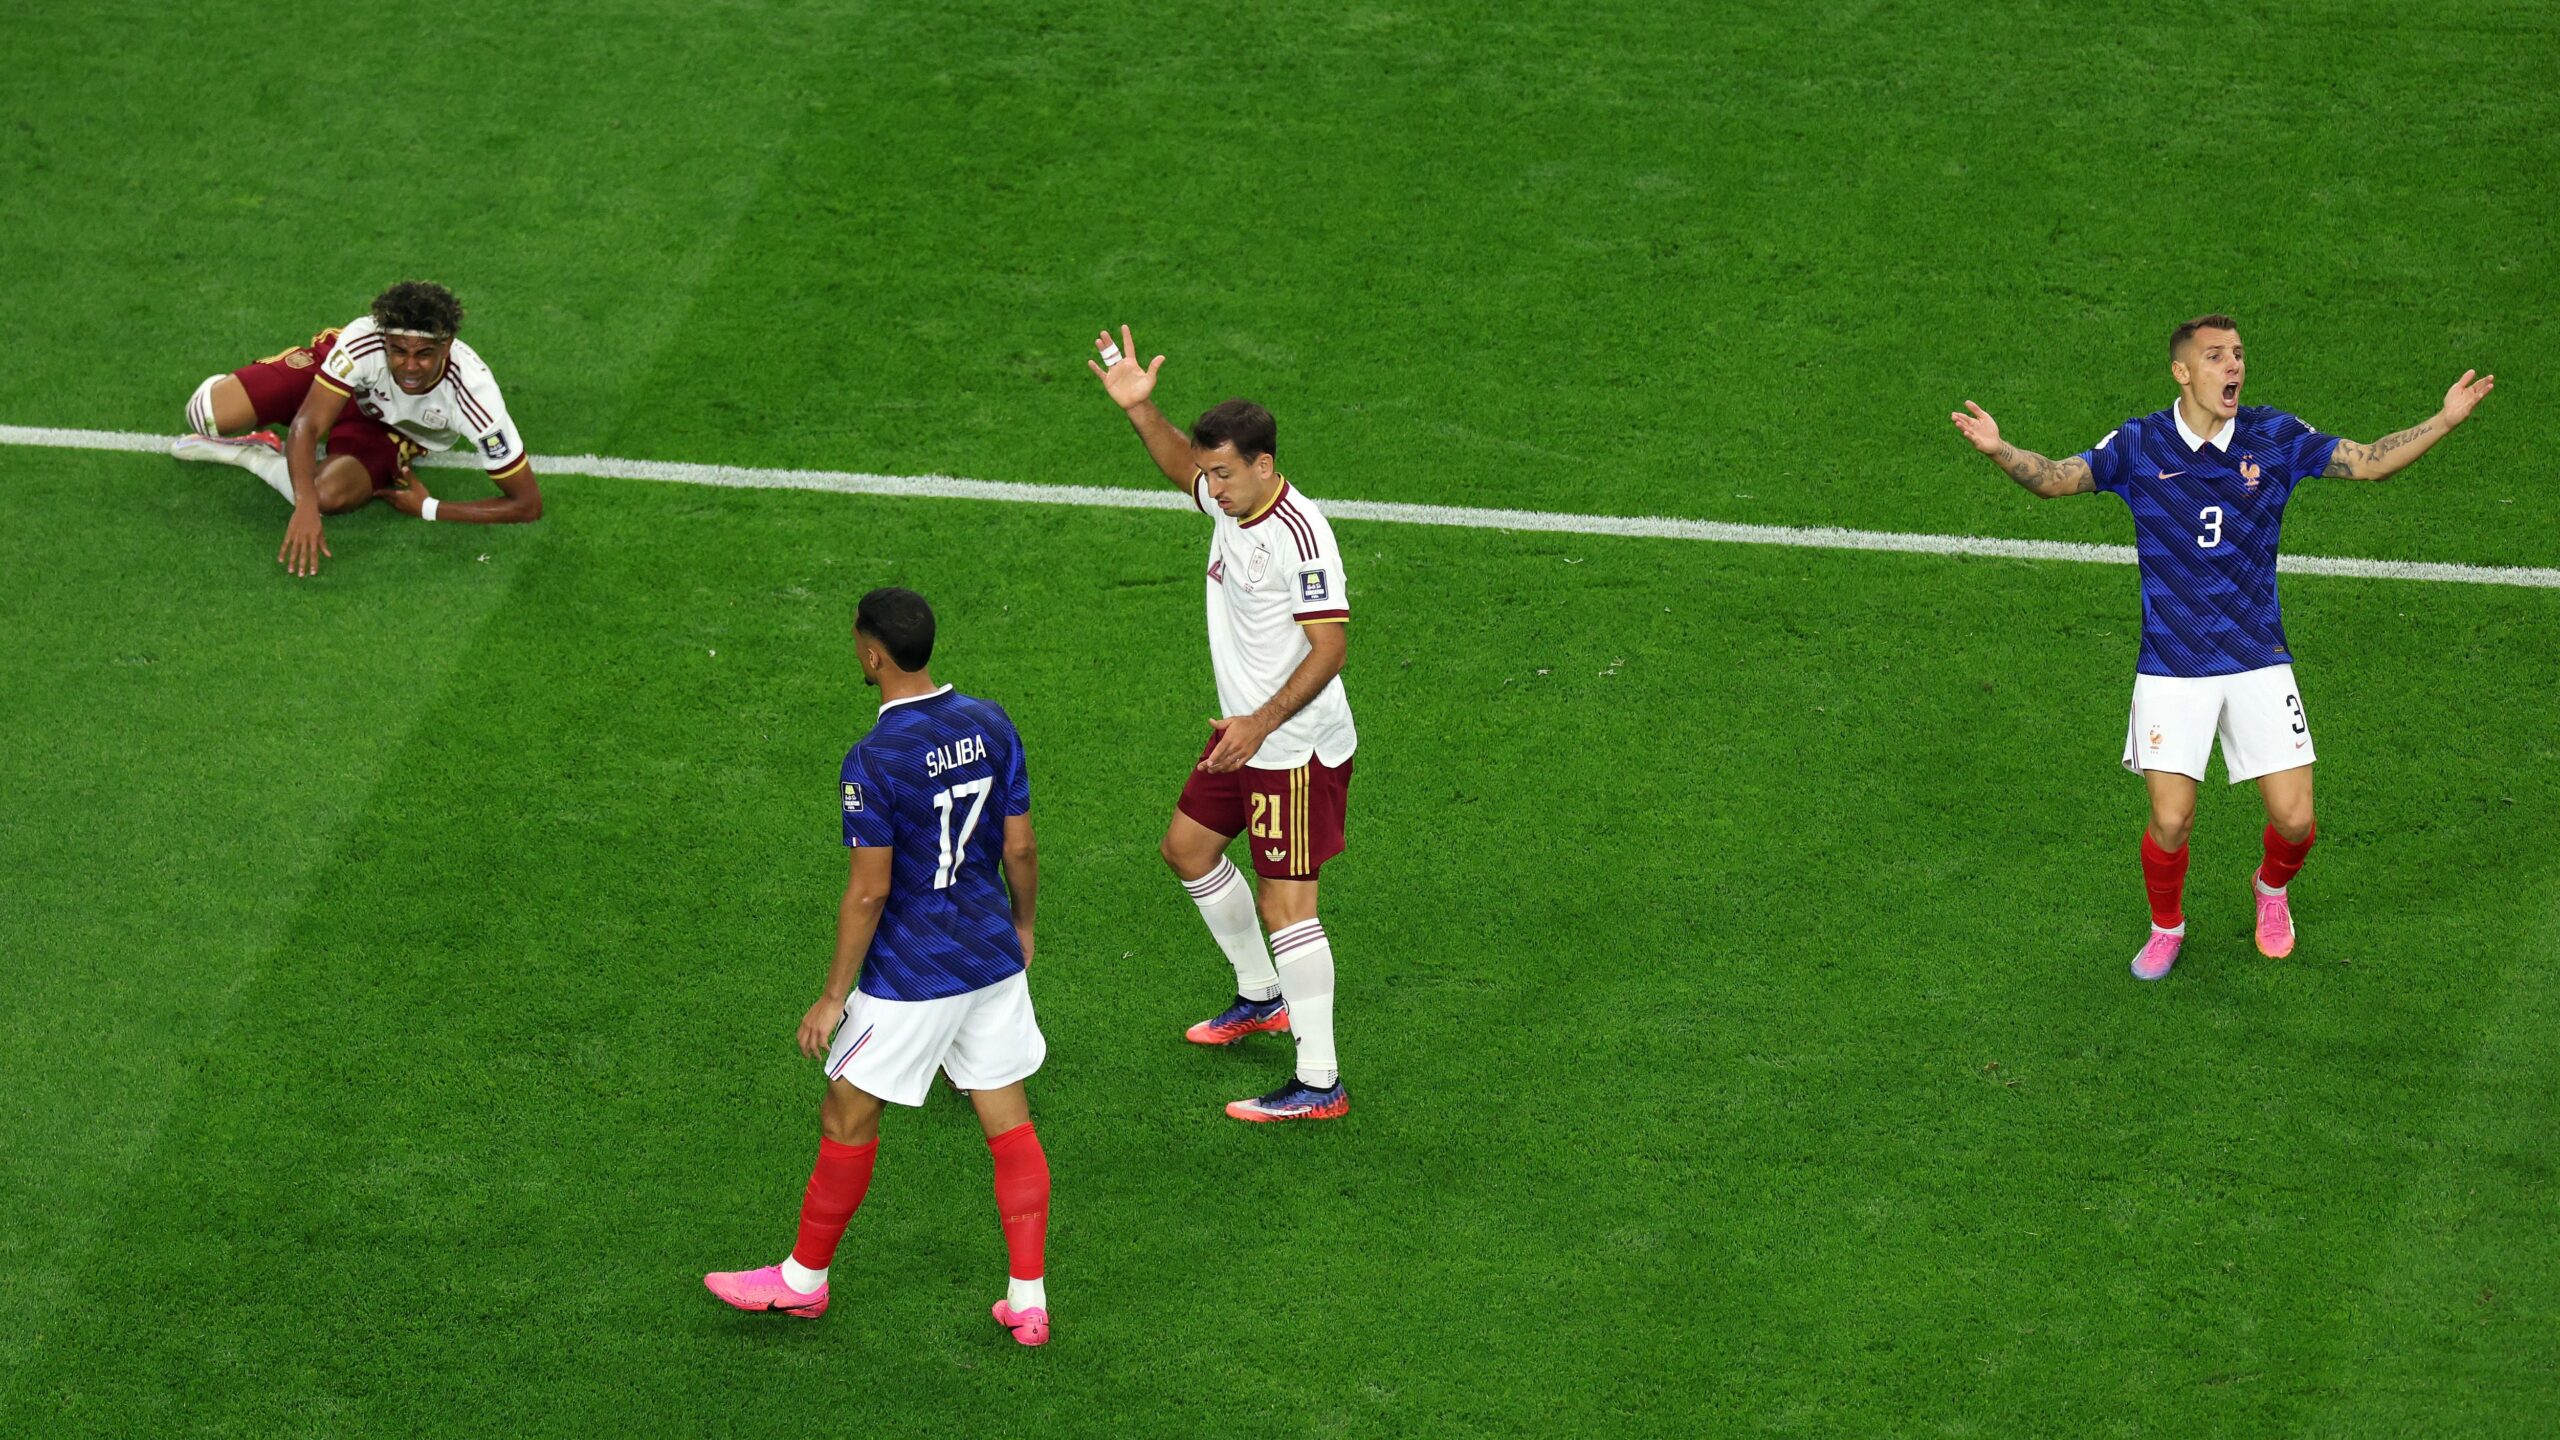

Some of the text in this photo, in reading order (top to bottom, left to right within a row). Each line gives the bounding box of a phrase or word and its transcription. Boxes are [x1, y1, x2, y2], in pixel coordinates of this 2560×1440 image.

[2197, 505, 2224, 548] 3
[2285, 693, 2306, 735] 3
[925, 734, 987, 778] SALIBA
[933, 776, 994, 890] 17
[1251, 791, 1283, 840] 21
